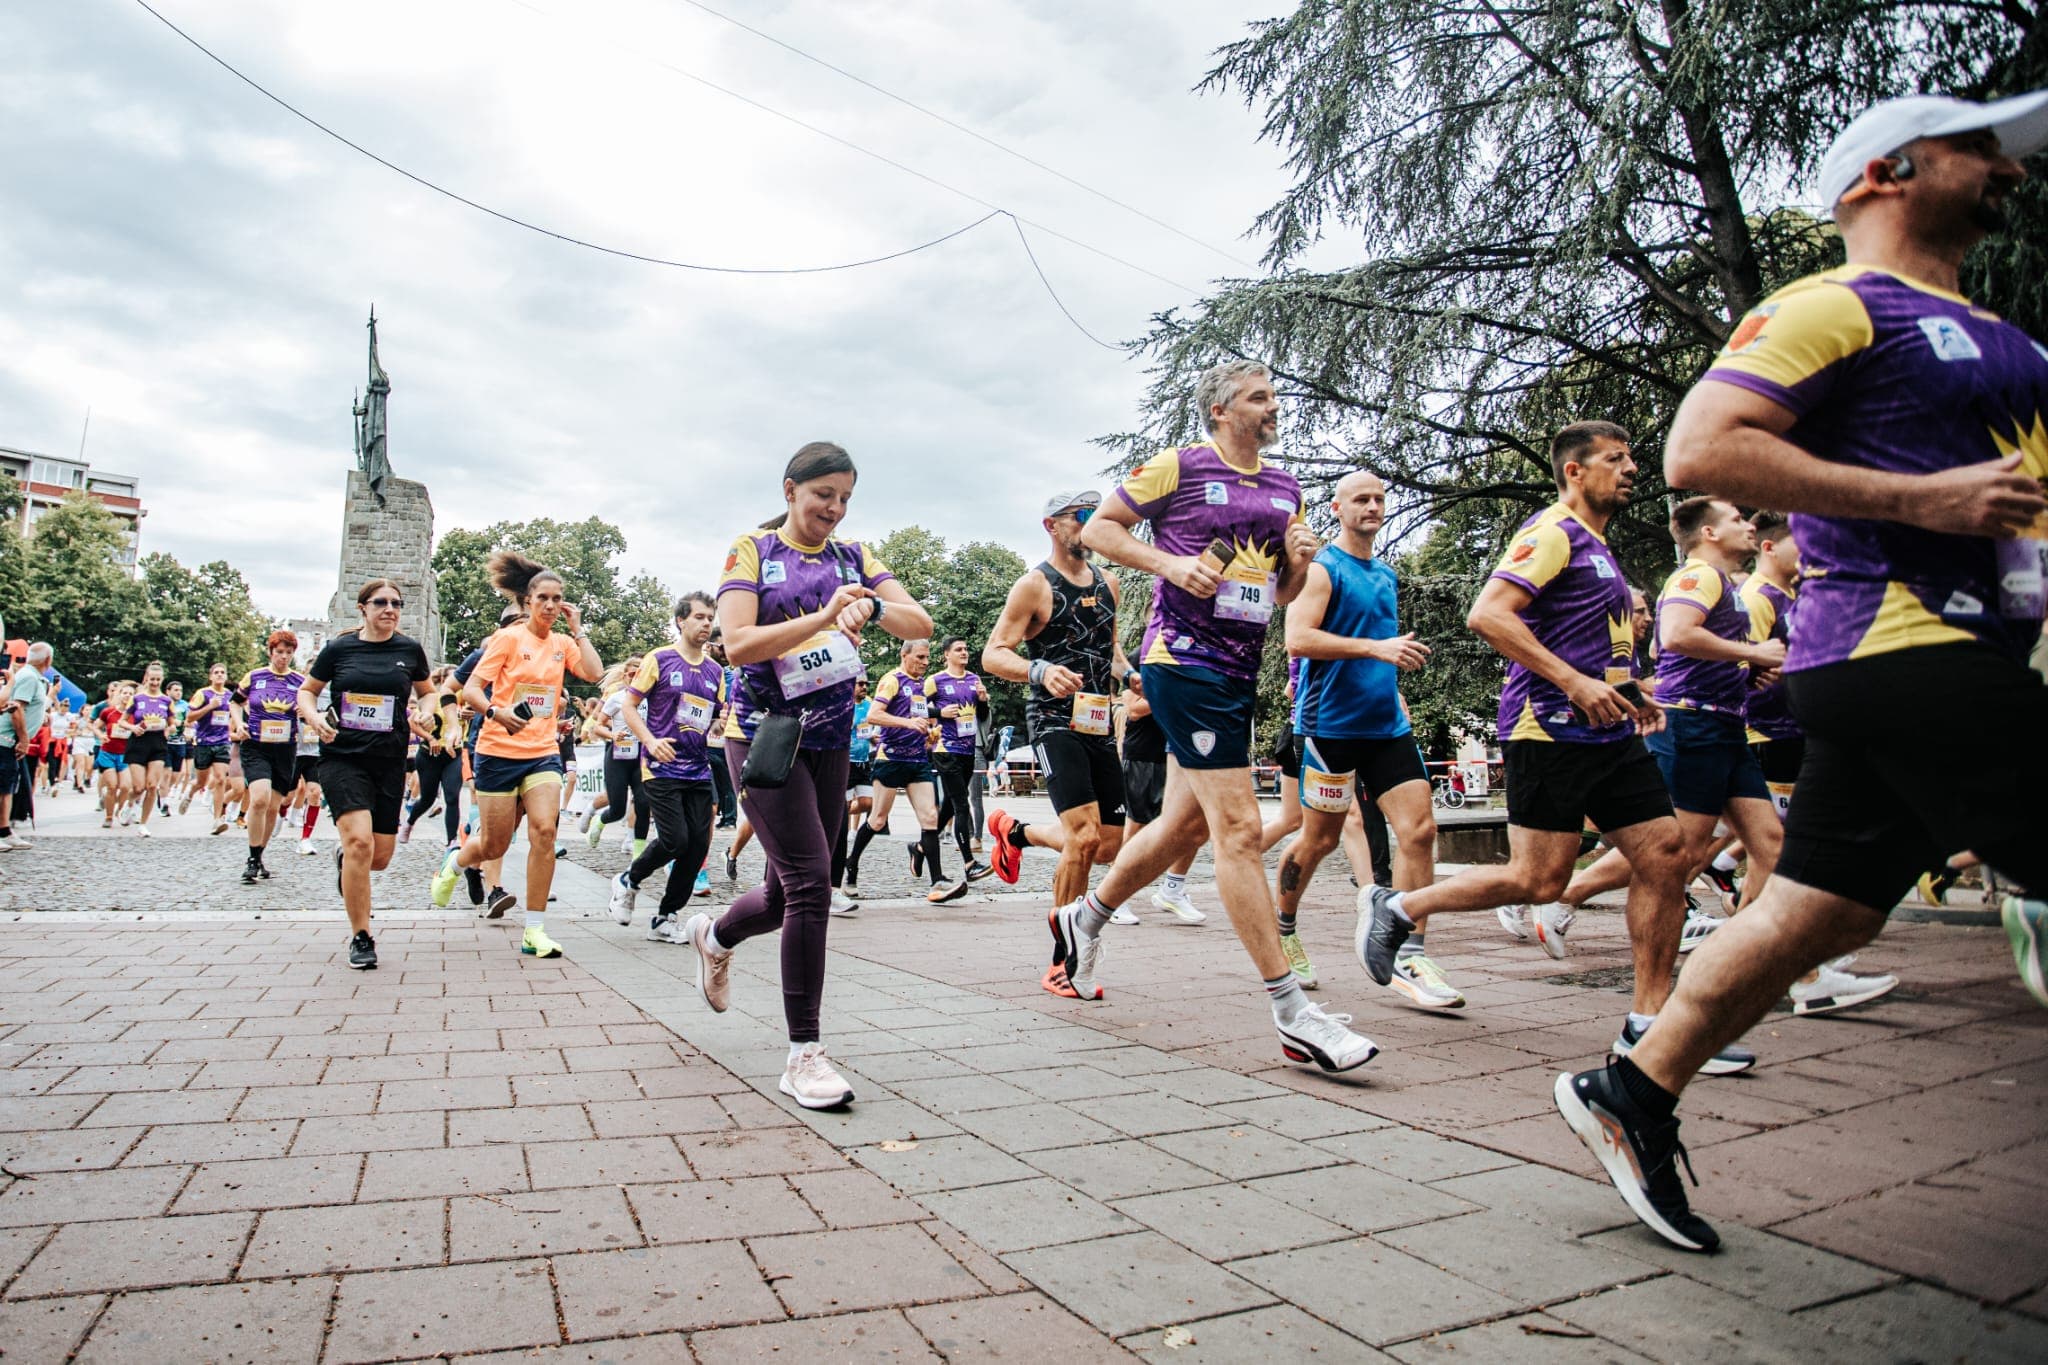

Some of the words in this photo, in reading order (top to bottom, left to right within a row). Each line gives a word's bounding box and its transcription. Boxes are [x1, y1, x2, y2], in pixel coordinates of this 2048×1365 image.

[1240, 586, 1260, 603] 749
[800, 648, 832, 671] 534
[358, 706, 376, 718] 752
[691, 706, 702, 718] 761
[1319, 787, 1343, 799] 1155
